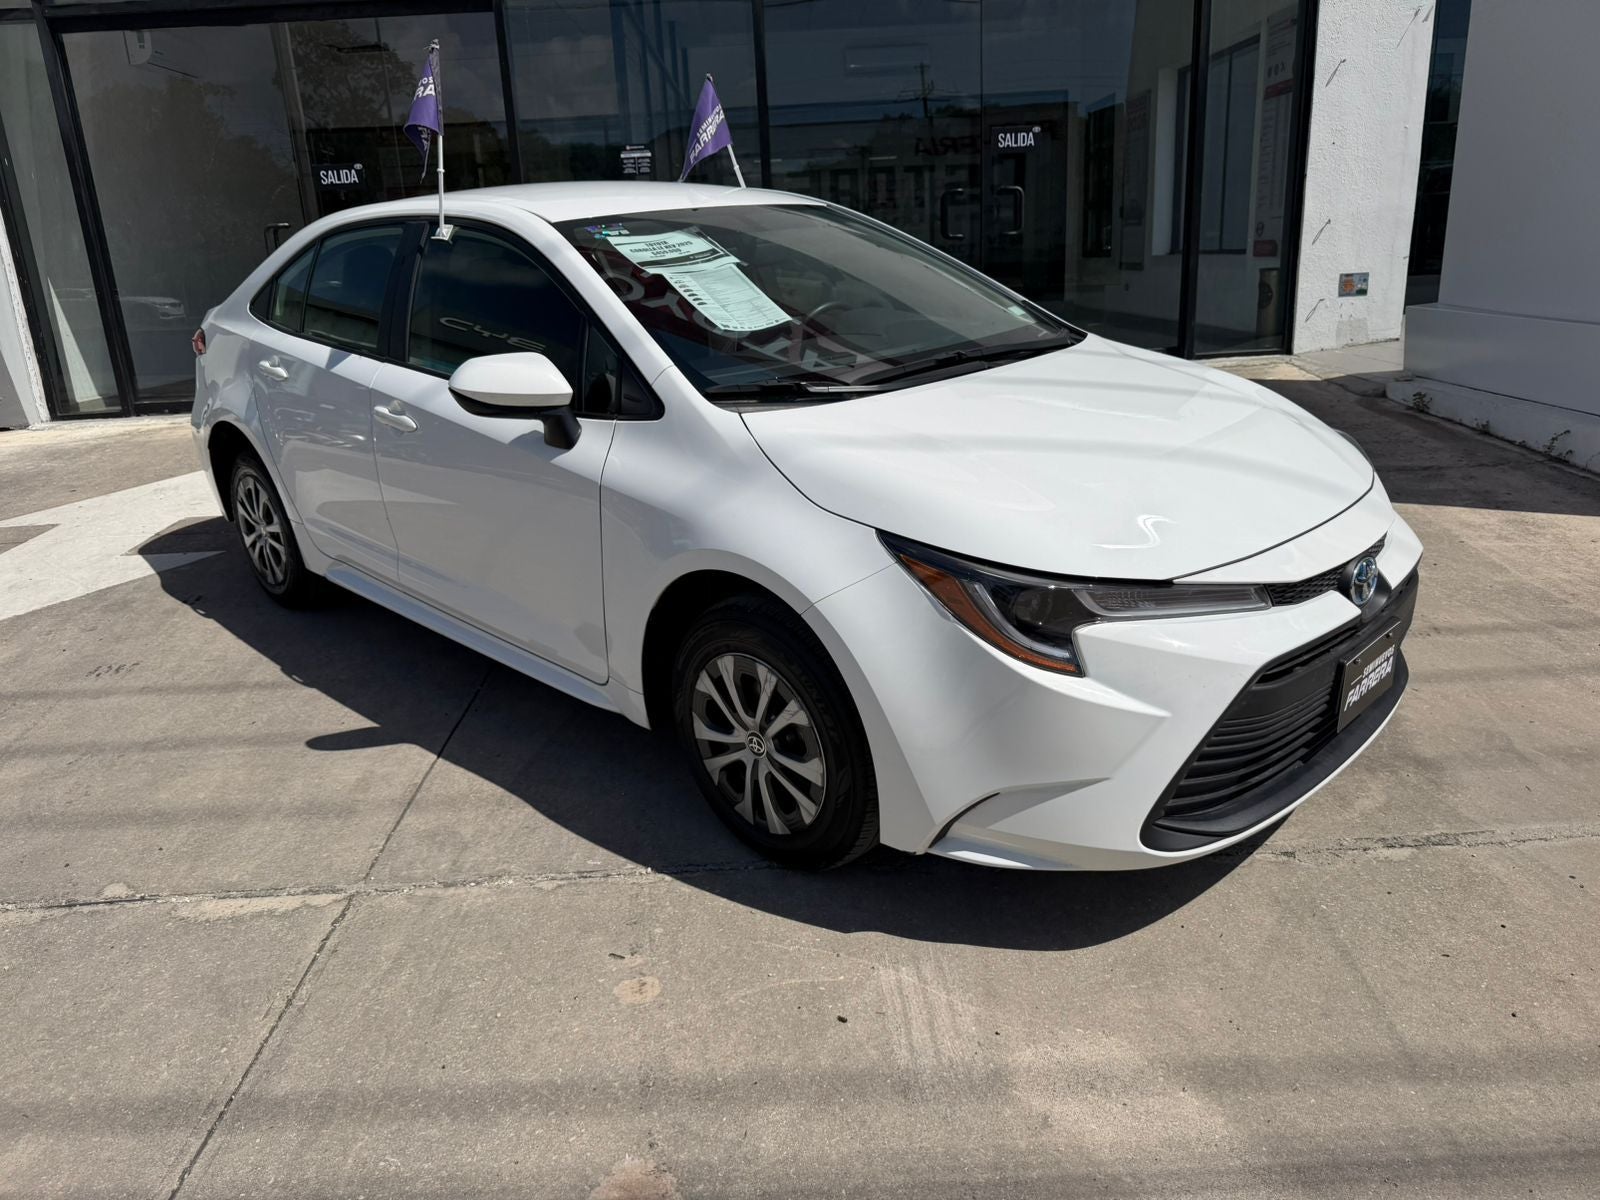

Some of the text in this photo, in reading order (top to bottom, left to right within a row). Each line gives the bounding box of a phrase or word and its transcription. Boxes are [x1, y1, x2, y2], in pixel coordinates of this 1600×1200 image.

[998, 132, 1034, 147] SALIDA
[320, 169, 359, 184] SALIDA
[1344, 656, 1393, 711] FARRERA
